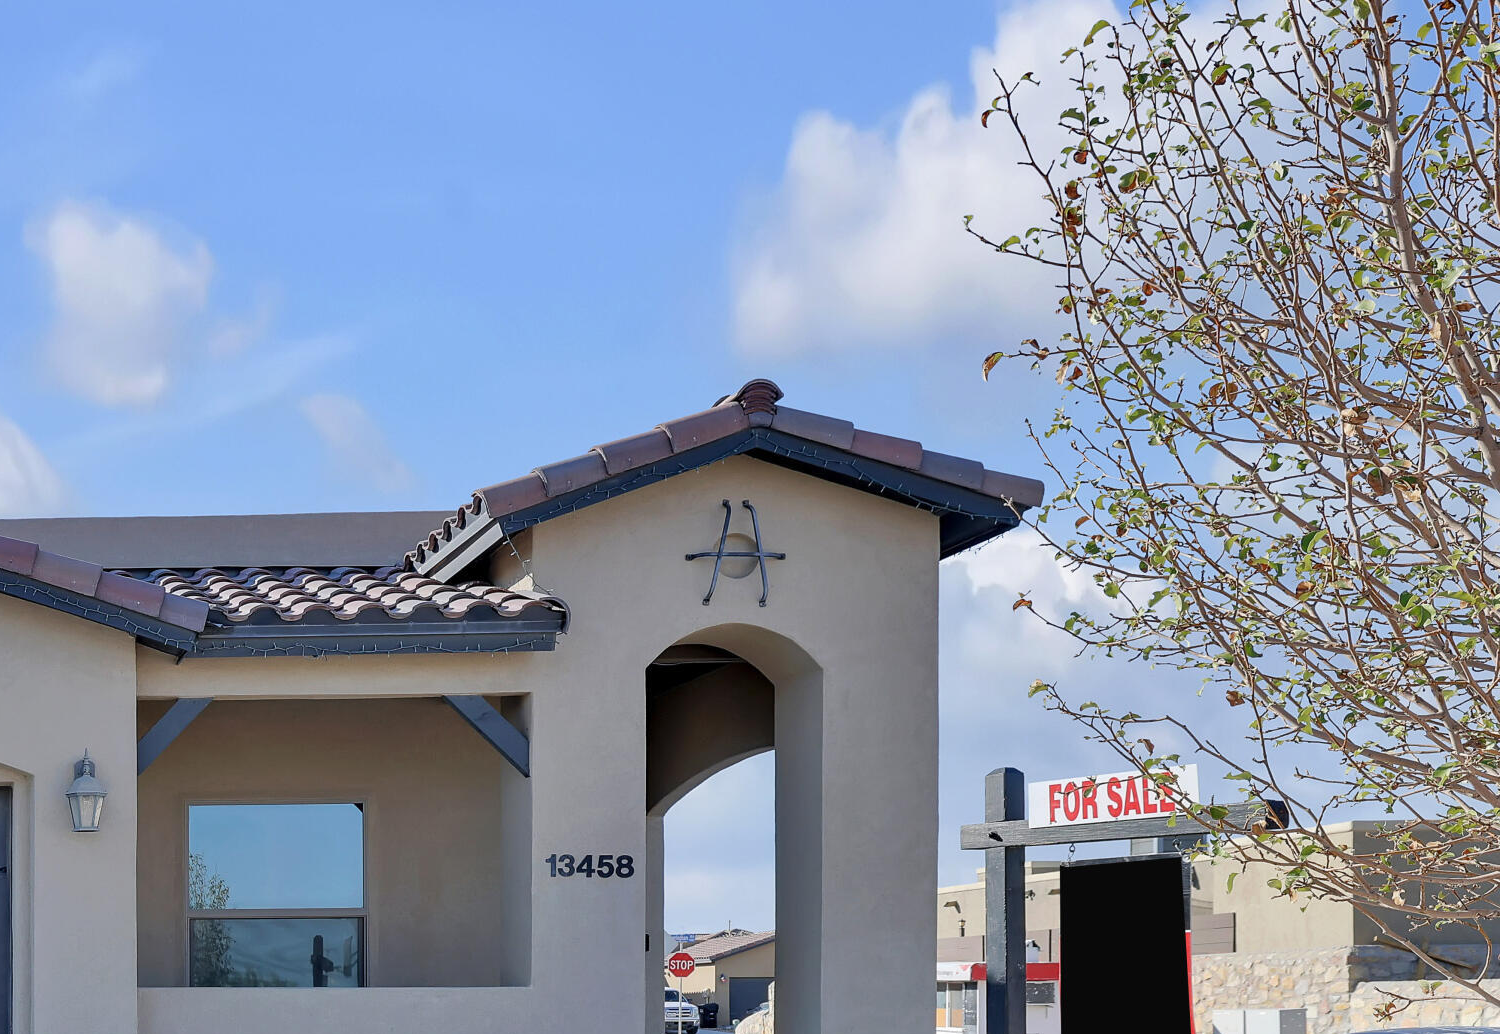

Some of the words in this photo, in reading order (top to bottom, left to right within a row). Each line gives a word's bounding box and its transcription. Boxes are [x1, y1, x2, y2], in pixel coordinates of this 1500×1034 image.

[1049, 780, 1098, 823] FOR
[1107, 772, 1176, 818] SALE
[545, 854, 635, 878] 13458
[669, 959, 694, 970] STOP
